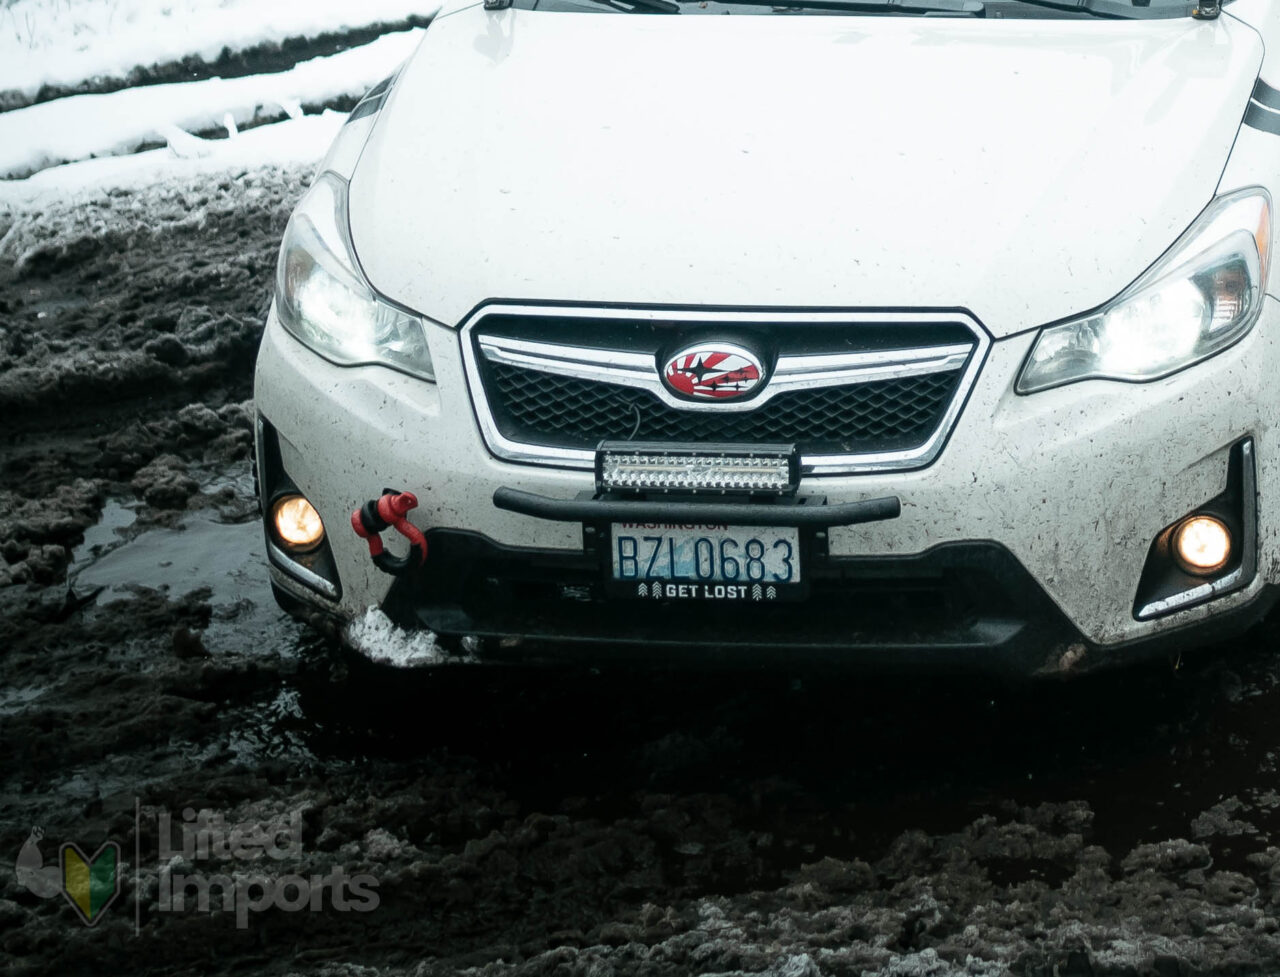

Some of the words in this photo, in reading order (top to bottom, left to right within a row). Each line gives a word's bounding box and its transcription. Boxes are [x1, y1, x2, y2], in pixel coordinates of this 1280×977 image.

[617, 535, 793, 583] BZL0683
[665, 584, 699, 598] GET
[704, 585, 748, 599] LOST
